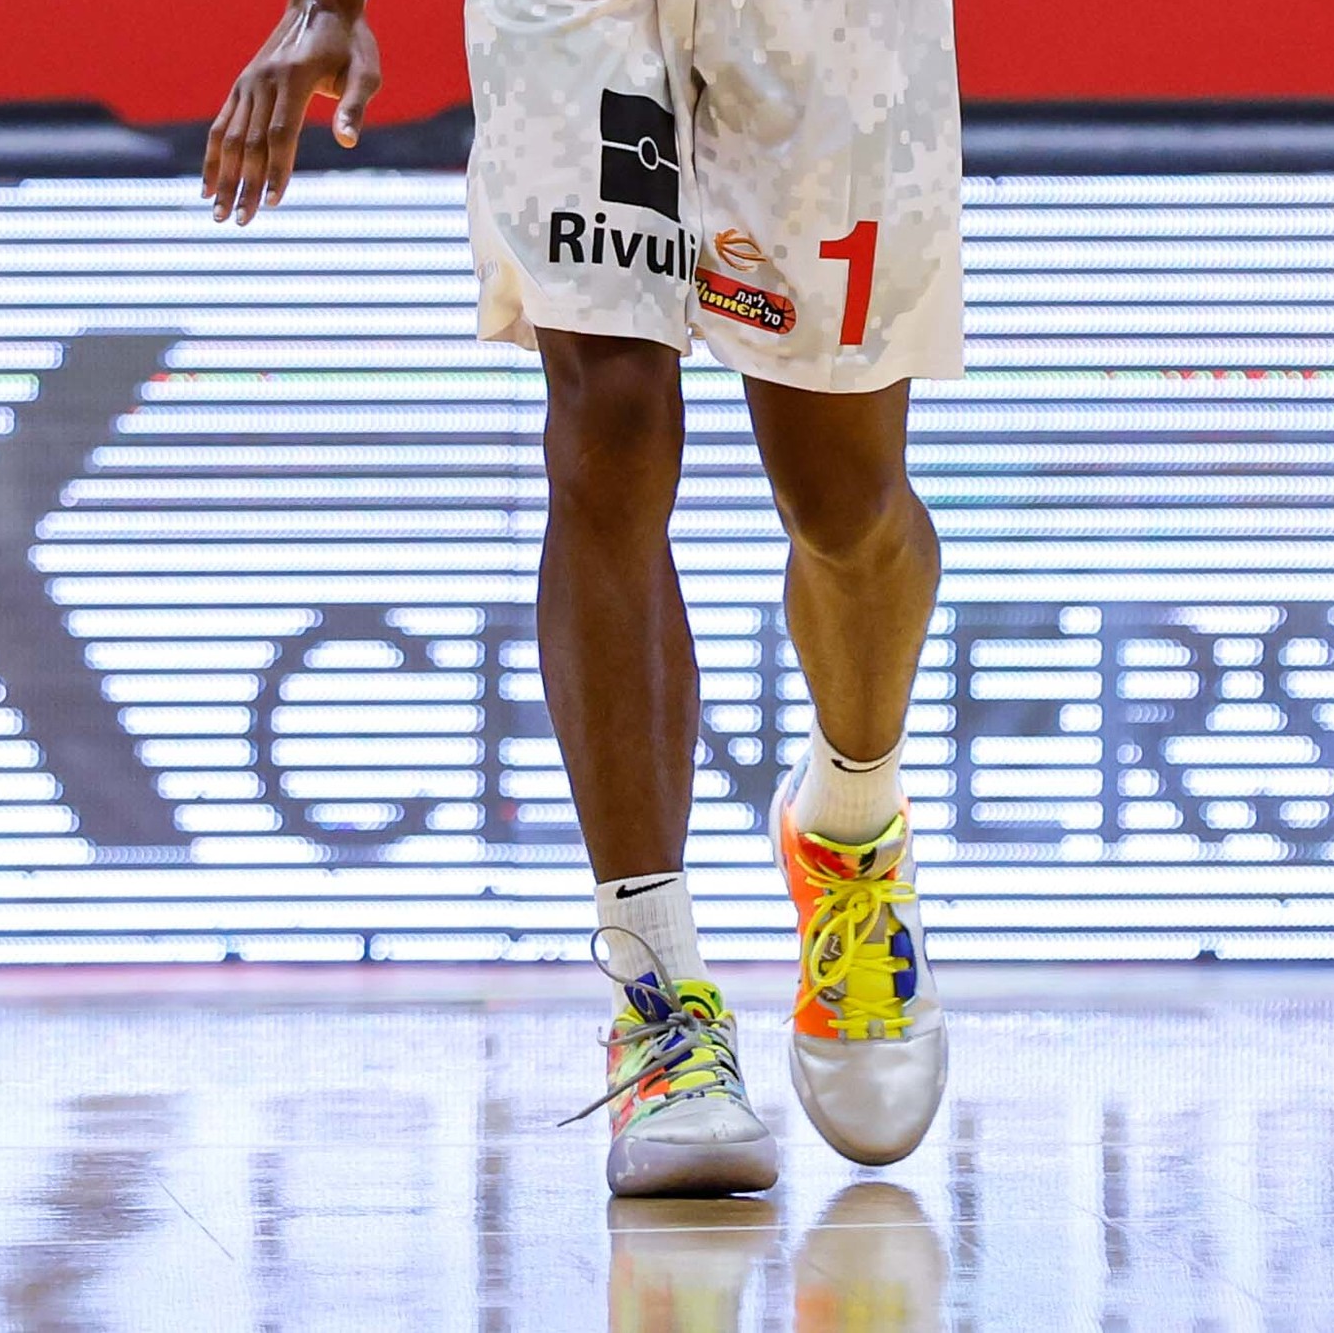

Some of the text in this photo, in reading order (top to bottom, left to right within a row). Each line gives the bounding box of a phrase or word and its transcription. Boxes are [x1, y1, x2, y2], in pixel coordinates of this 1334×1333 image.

[818, 220, 879, 346] 1
[735, 290, 766, 308] ליגת
[764, 306, 782, 326] סל
